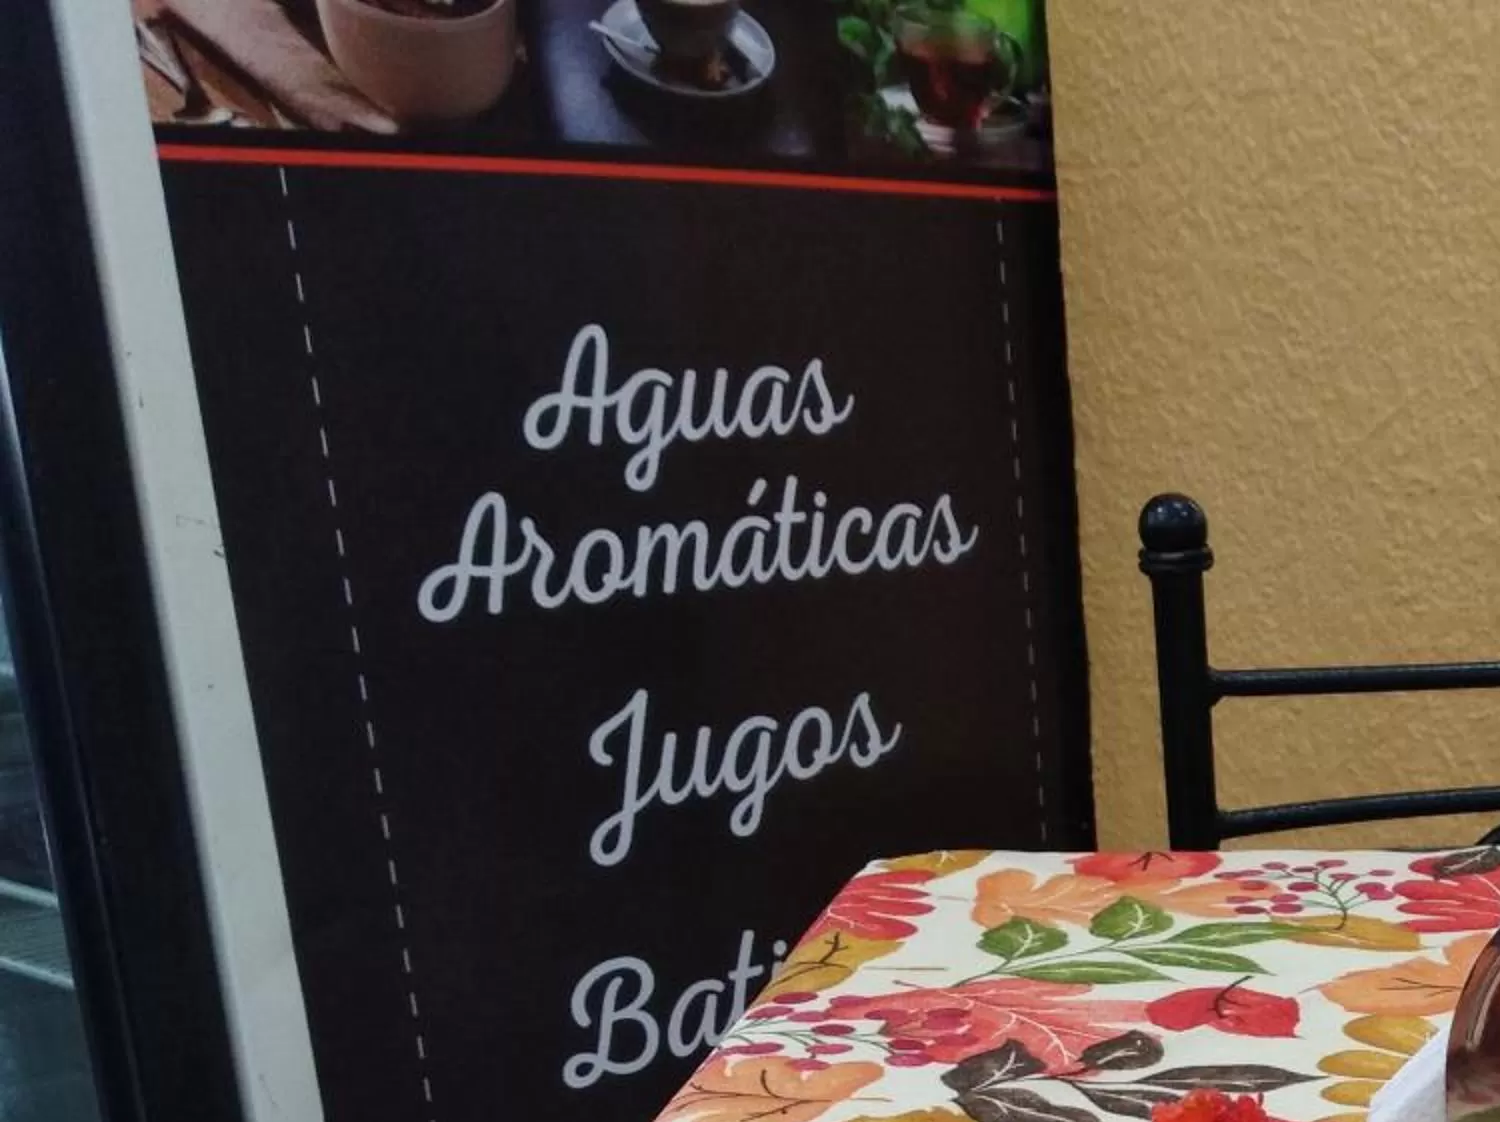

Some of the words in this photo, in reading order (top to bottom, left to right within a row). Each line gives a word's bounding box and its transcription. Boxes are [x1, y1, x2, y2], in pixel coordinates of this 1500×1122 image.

[524, 324, 854, 491] Aguas
[418, 475, 978, 622] Aromáticas
[589, 688, 901, 866] Jugos
